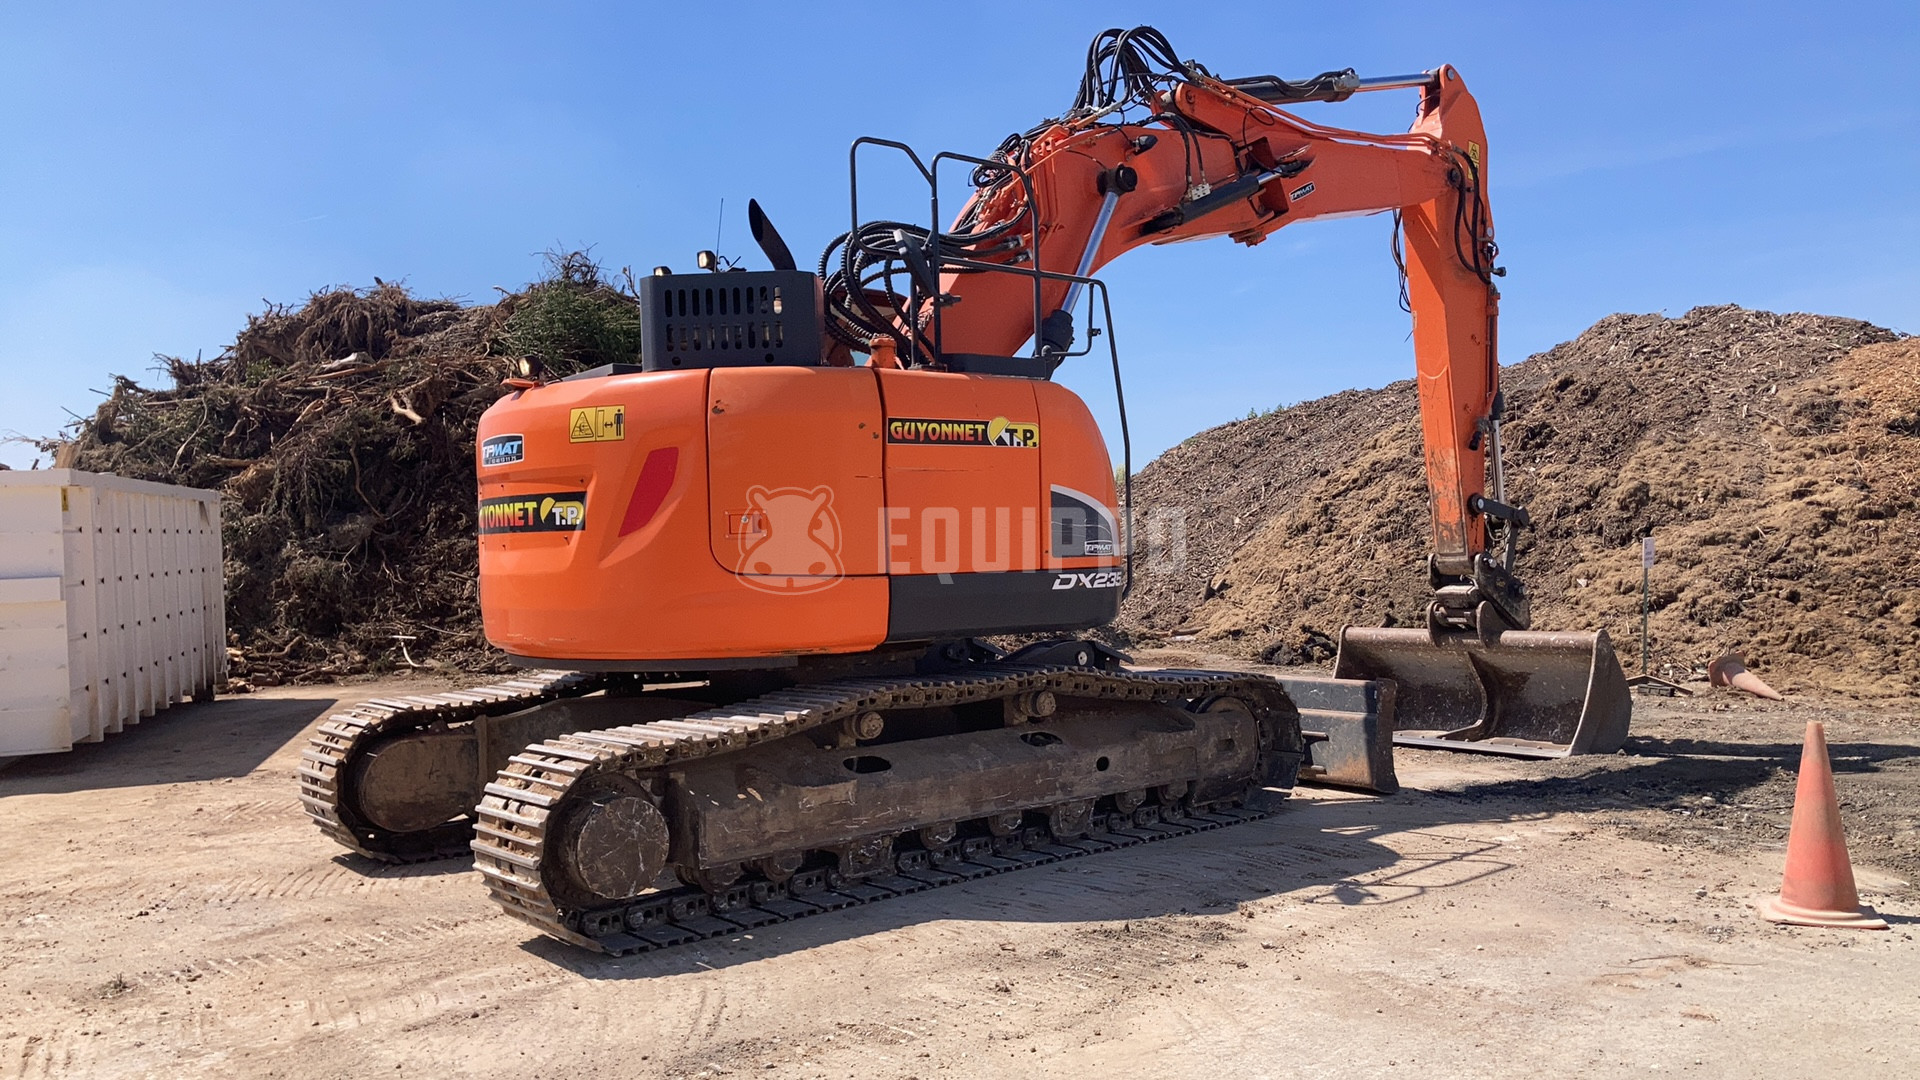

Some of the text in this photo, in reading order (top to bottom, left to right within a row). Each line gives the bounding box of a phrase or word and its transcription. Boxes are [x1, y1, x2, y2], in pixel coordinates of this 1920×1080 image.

[889, 421, 1037, 447] GUYONNET T.P.
[552, 506, 580, 526] T.P.
